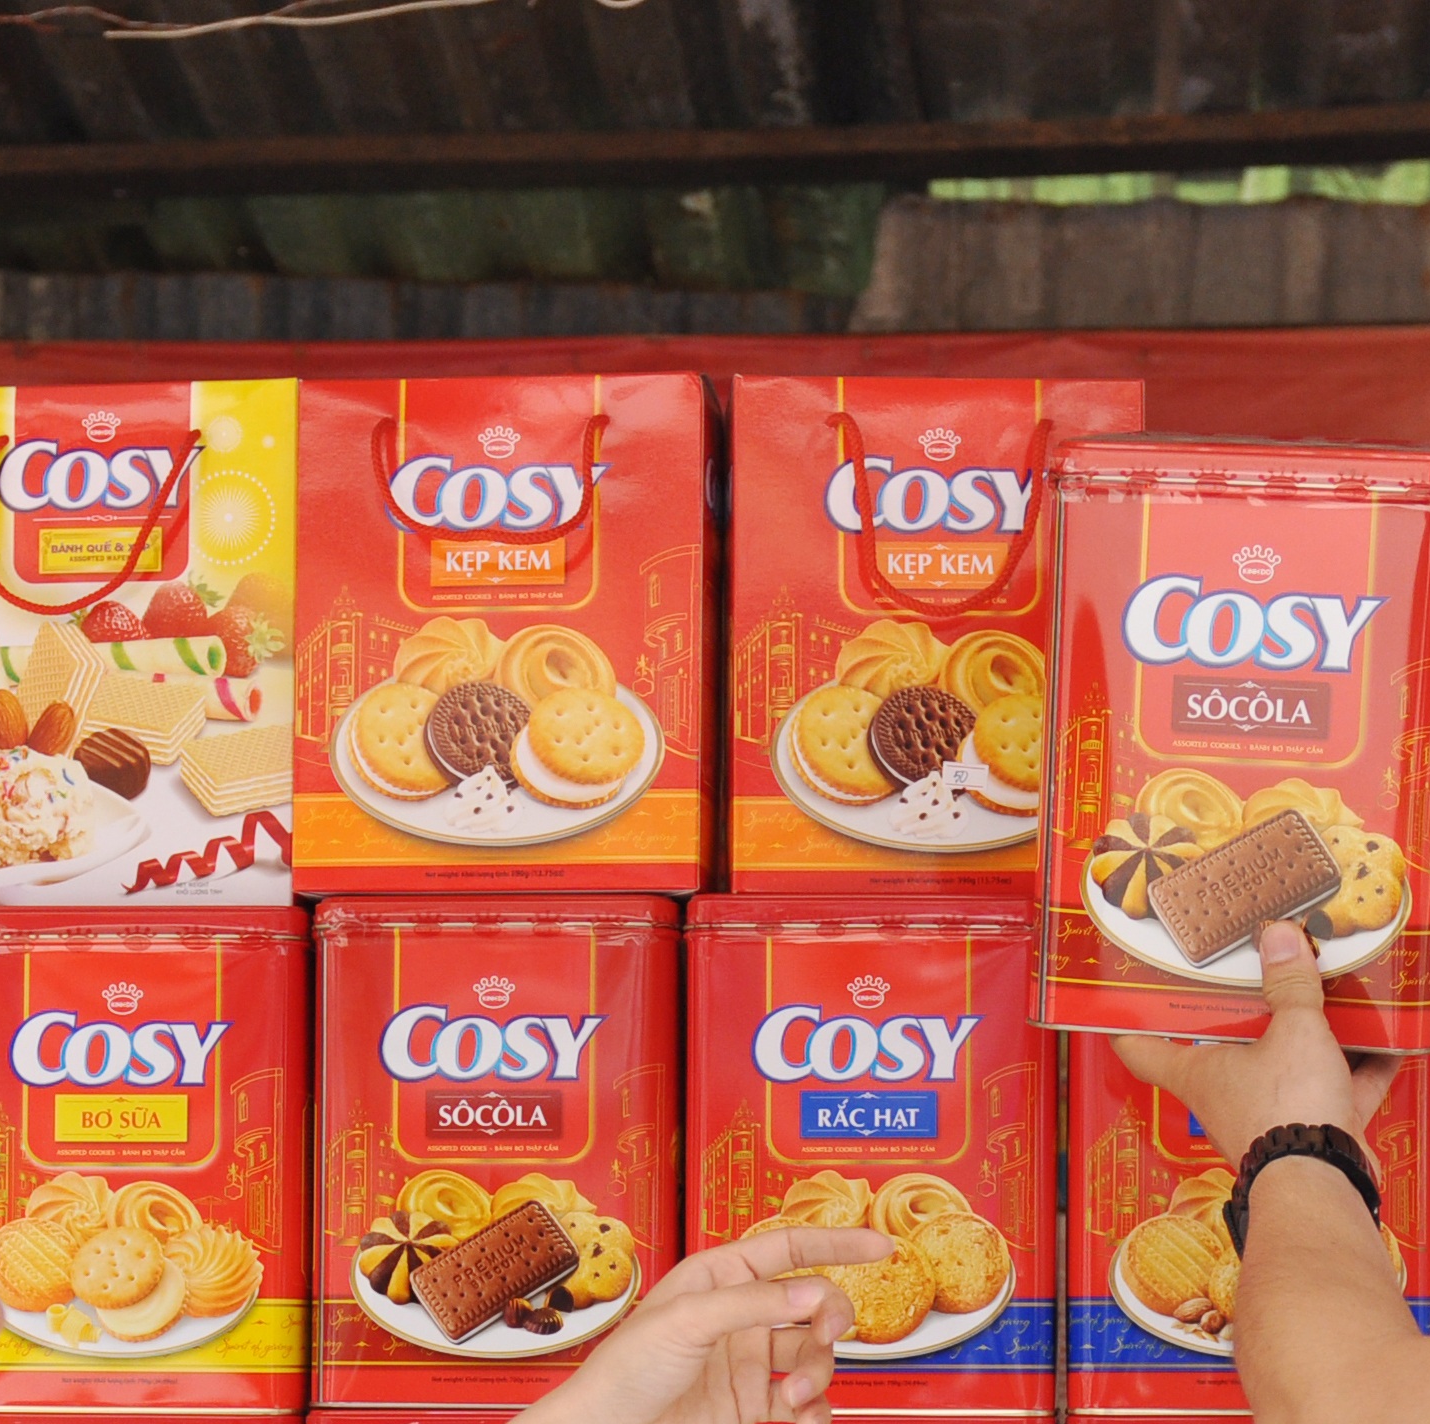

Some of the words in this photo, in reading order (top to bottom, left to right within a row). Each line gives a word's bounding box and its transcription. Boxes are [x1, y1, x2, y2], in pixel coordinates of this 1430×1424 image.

[389, 454, 613, 534] COSY
[823, 454, 1048, 534] COSY
[445, 550, 490, 578] KẸP
[498, 549, 551, 572] KEM
[887, 552, 932, 581] KẸP
[940, 553, 994, 575] KEM
[1121, 573, 1390, 672] COSY
[1186, 687, 1312, 725] SÔCÔLA
[1196, 849, 1286, 904] PREMIUM
[8, 1009, 235, 1088] COSY
[378, 1002, 611, 1083] COSY
[751, 1002, 986, 1083] COSY
[119, 1106, 162, 1129] SỮA
[438, 1098, 548, 1127] SÔCÔLA
[817, 1098, 866, 1128] RẮC
[873, 1107, 920, 1131] HẠT
[450, 1234, 531, 1291] PREMIUM
